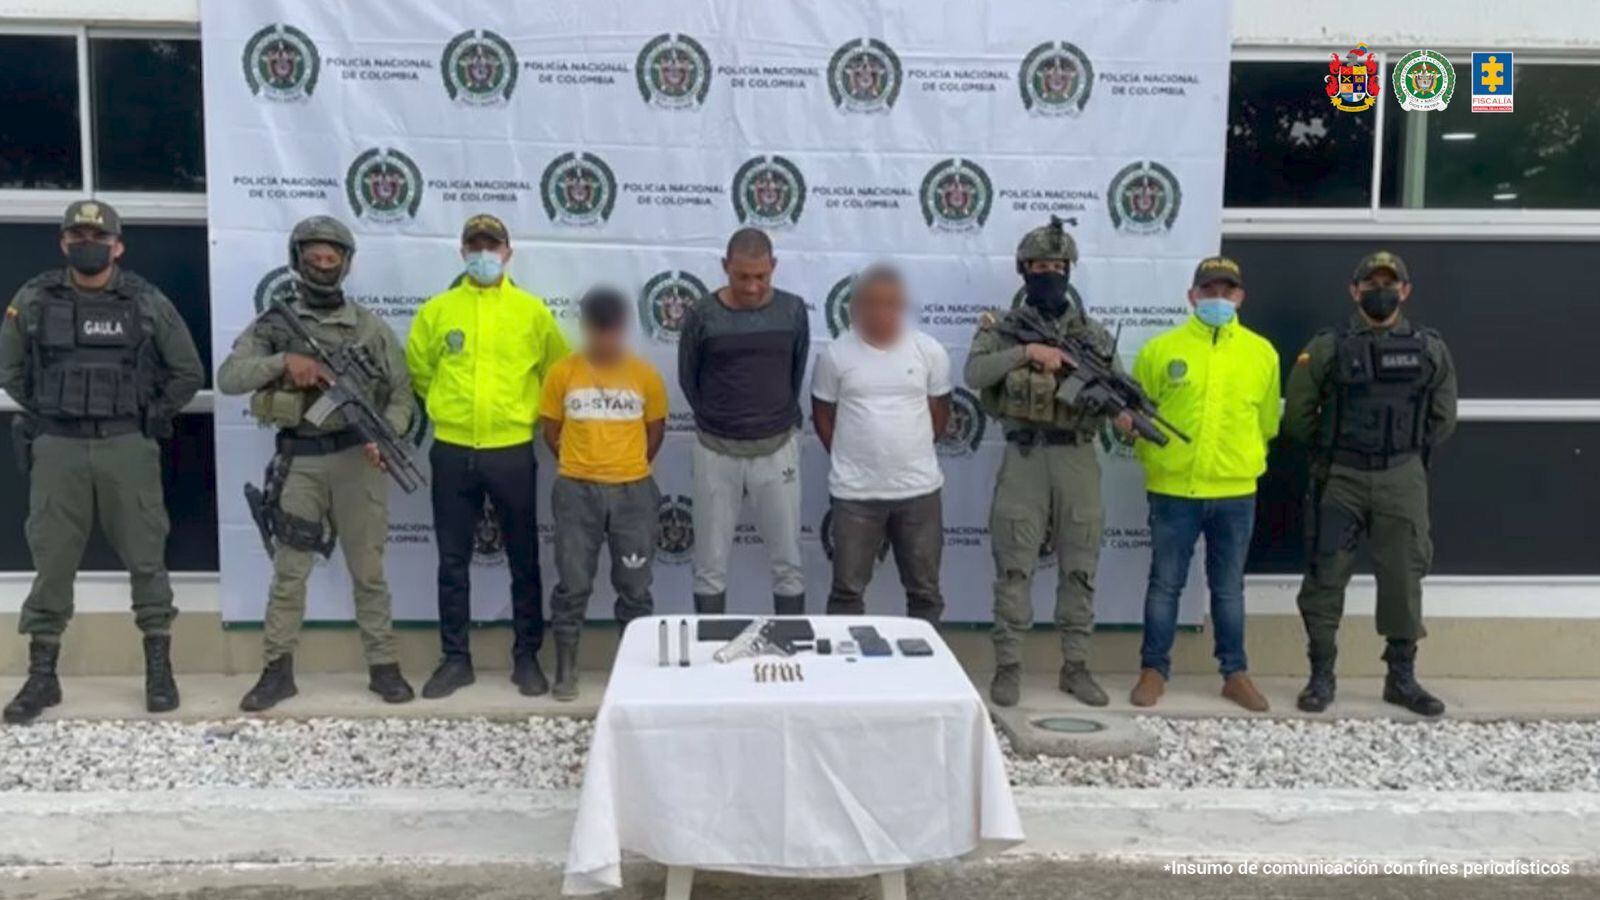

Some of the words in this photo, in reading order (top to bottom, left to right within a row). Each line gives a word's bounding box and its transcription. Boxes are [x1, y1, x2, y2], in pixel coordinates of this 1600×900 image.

[374, 59, 433, 69] NACIONAL
[571, 62, 629, 73] NACIONAL
[342, 70, 356, 80] DE
[359, 70, 419, 80] COLOMBIA
[762, 67, 819, 77] NACIONAL
[954, 70, 1010, 80] NACIONAL
[538, 74, 552, 83] DE
[556, 74, 615, 84] COLOMBIA
[731, 78, 744, 88] DE
[748, 78, 806, 88] COLOMBIA
[1143, 73, 1200, 84] NACIONAL
[921, 82, 935, 91] DE
[938, 82, 996, 92] COLOMBIA
[1111, 86, 1125, 95] DE
[1128, 86, 1186, 96] COLOMBIA
[281, 177, 340, 188] NACIONAL
[473, 181, 531, 191] NACIONAL
[248, 189, 262, 198] DE
[266, 190, 327, 199] COLOMBIA
[669, 184, 725, 194] NACIONAL
[857, 187, 912, 197] NACIONAL
[442, 192, 456, 202] DE
[460, 192, 518, 202] COLOMBIA
[1045, 190, 1100, 200] NACIONAL
[637, 195, 650, 205] DE
[654, 196, 713, 206] COLOMBIA
[825, 199, 840, 208] DE
[842, 199, 899, 209] COLOMBIA
[1013, 202, 1027, 211] DE
[1030, 202, 1087, 211] COLOMBIA
[83, 320, 124, 335] GAULA
